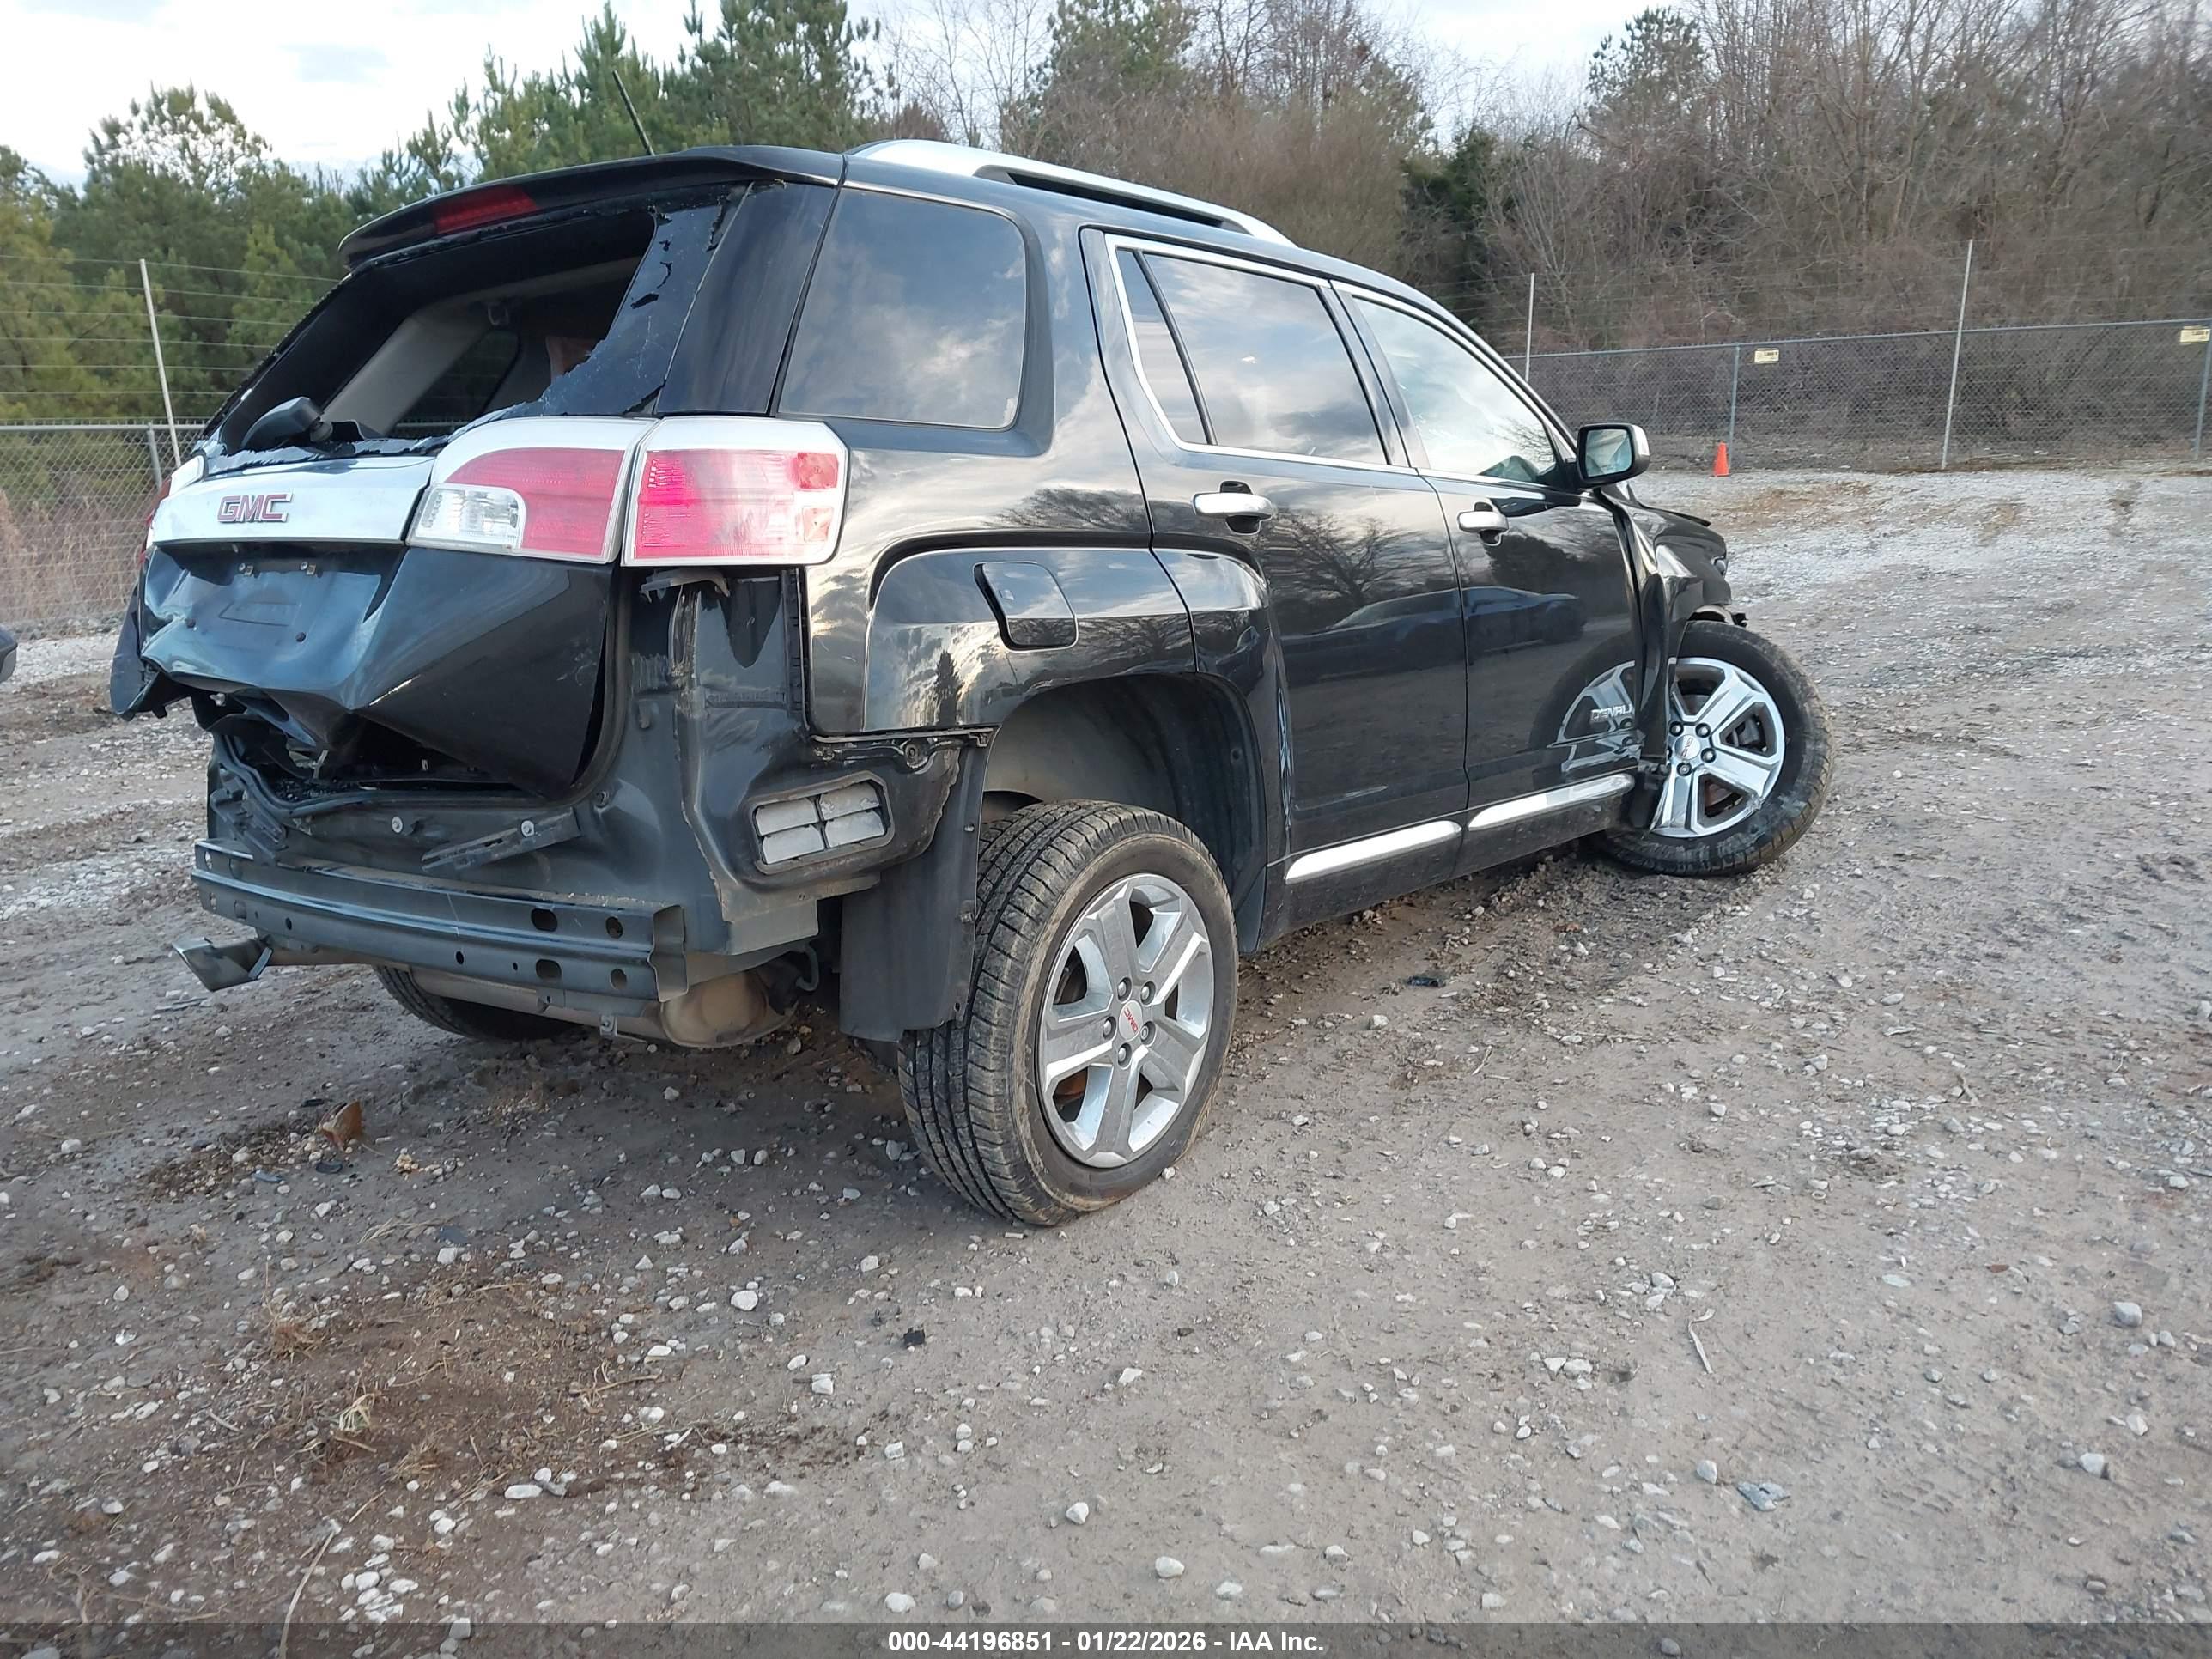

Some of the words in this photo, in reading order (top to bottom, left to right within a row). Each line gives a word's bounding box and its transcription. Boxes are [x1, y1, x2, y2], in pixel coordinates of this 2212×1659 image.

[217, 492, 294, 523] GMC
[1590, 704, 1633, 720] DENALI
[1123, 1006, 1139, 1034] GMC
